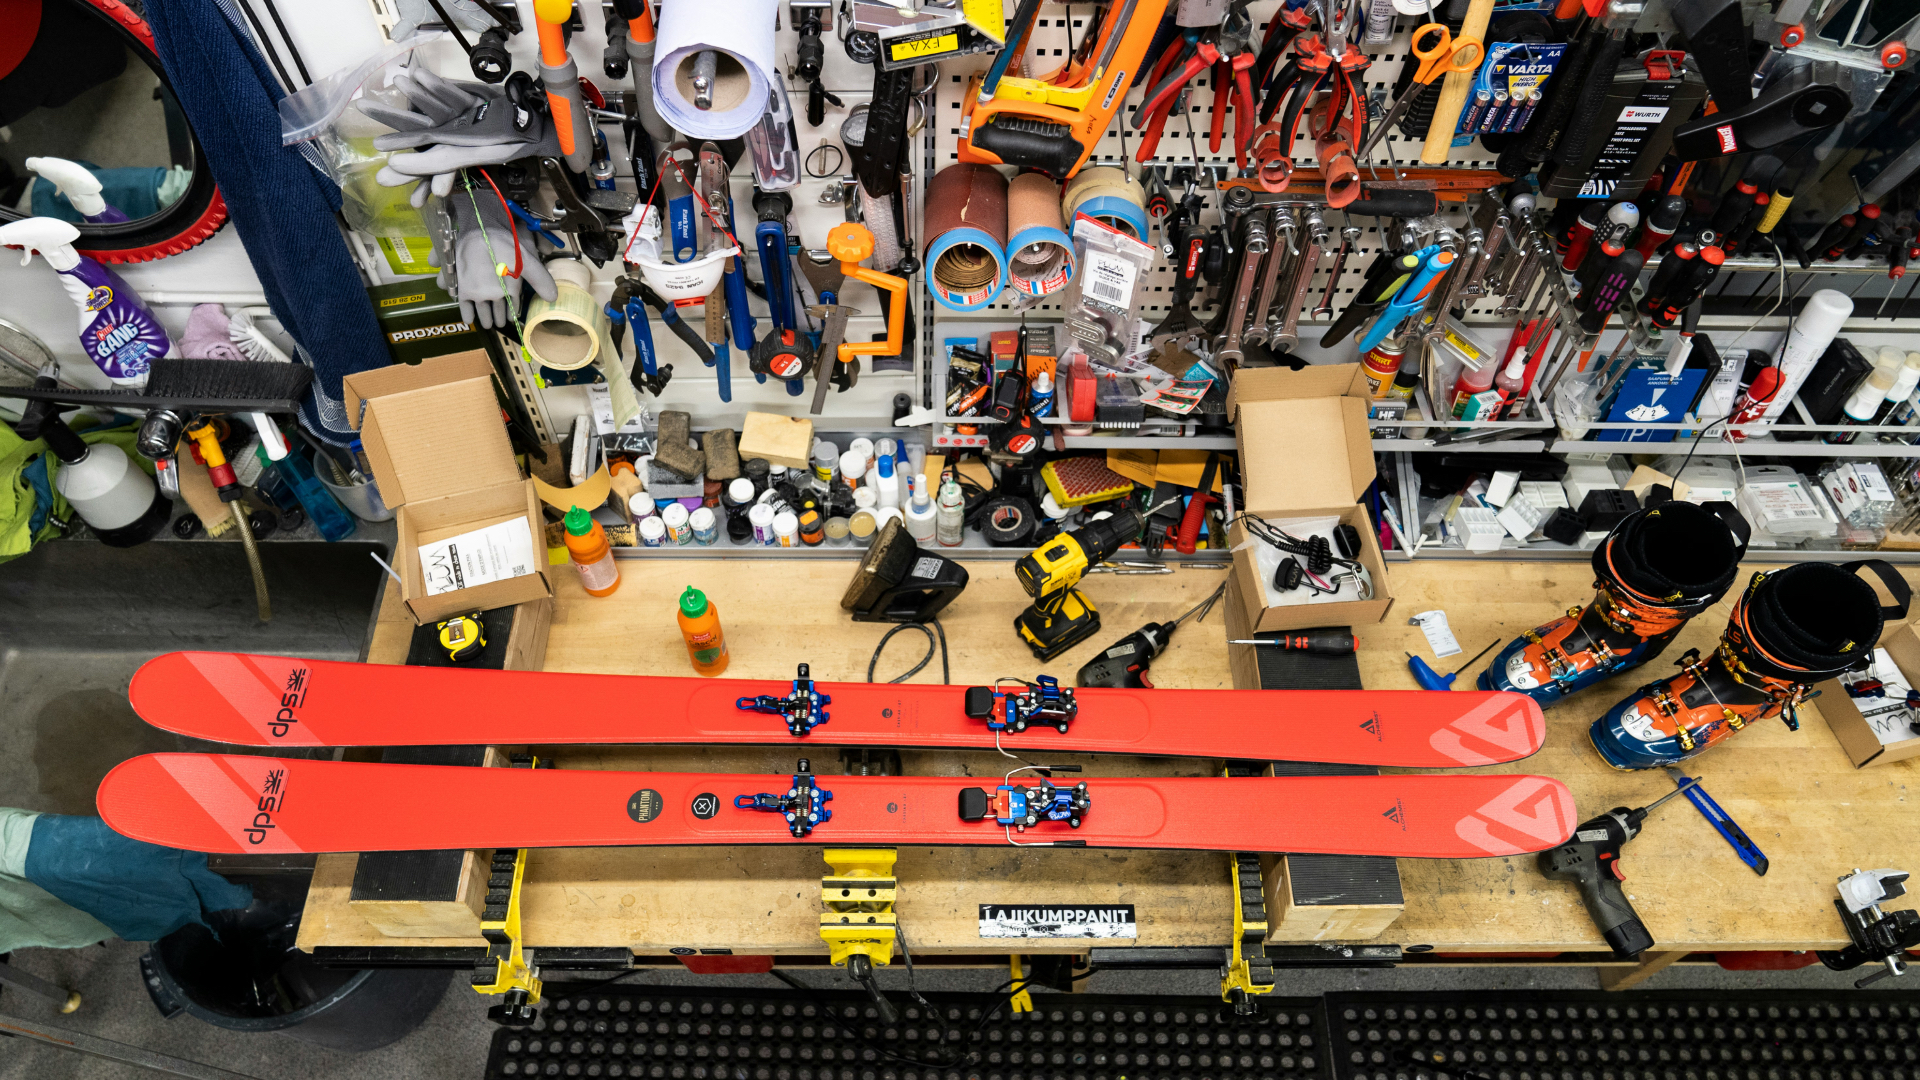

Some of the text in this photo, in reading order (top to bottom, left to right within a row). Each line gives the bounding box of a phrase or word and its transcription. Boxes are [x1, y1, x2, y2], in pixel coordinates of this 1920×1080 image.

[1508, 64, 1552, 74] VARTA
[1359, 102, 1368, 124] ZEBRA
[1483, 107, 1497, 125] VARTA
[1504, 107, 1518, 127] VARTA
[97, 322, 139, 358] BANG
[392, 322, 470, 342] PROXXON
[1370, 352, 1392, 366] START
[1378, 410, 1395, 418] HF
[1627, 428, 1647, 442] P
[267, 694, 298, 738] dps
[1373, 710, 1382, 742] ALCHEMIST
[639, 790, 651, 821] PHANTOM
[1396, 797, 1406, 832] ALCHEMIST
[244, 796, 278, 845] dps
[985, 909, 1129, 923] LAJIKUMPPANIT
